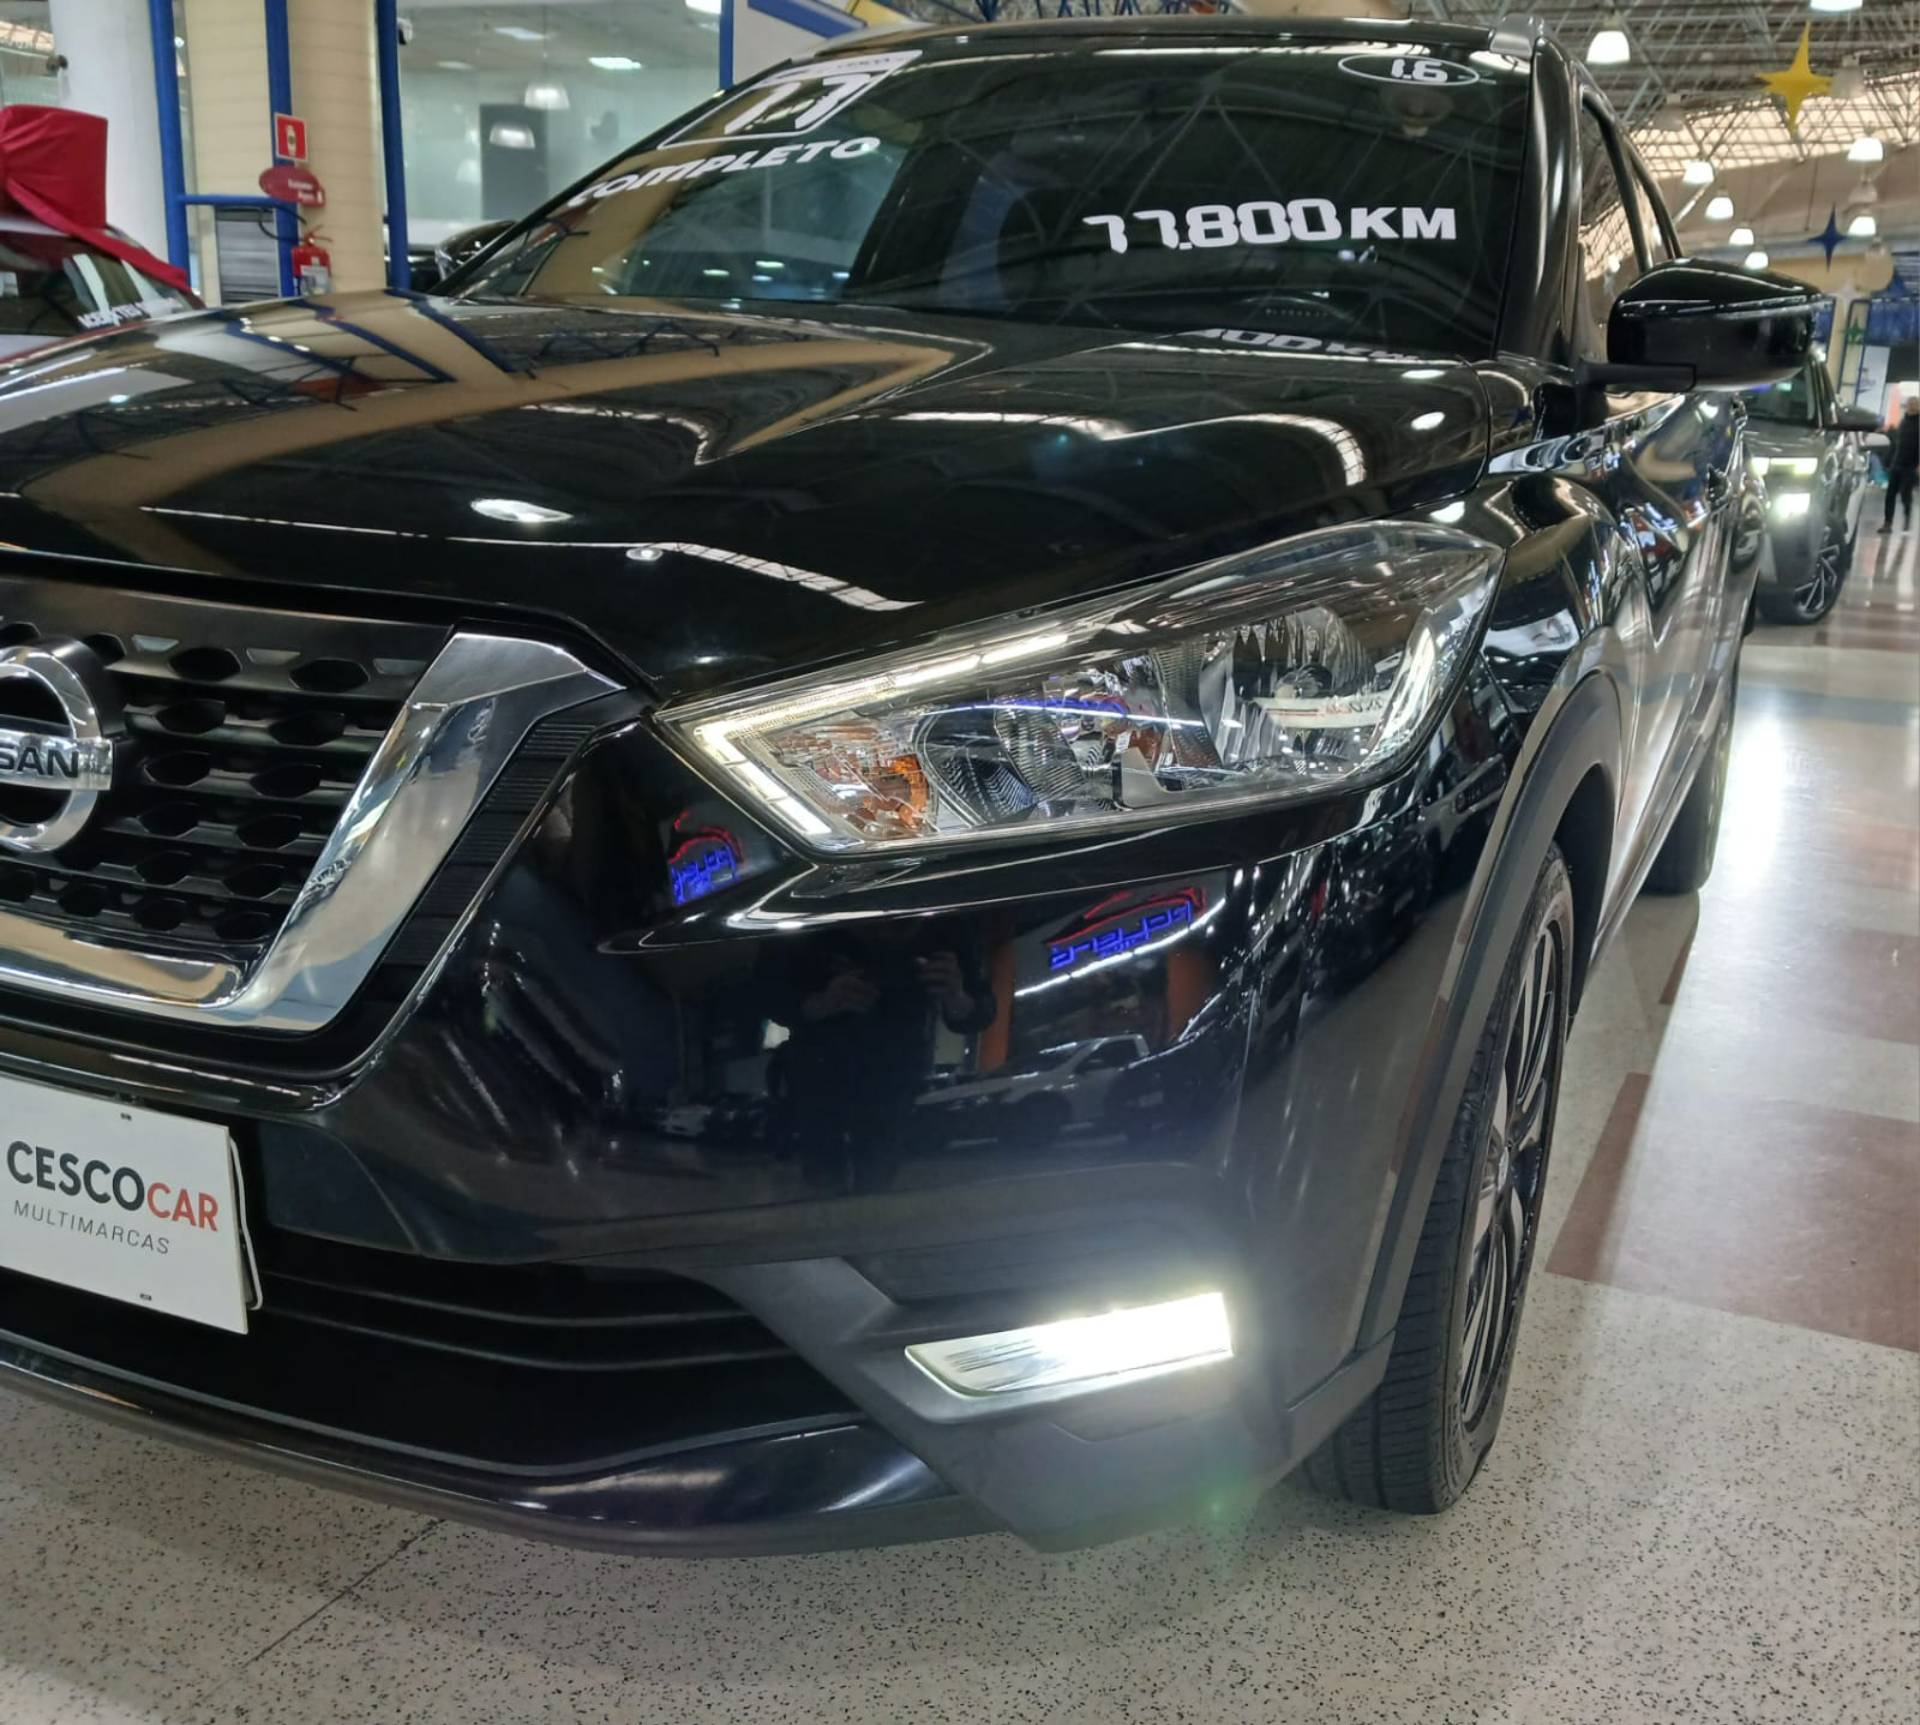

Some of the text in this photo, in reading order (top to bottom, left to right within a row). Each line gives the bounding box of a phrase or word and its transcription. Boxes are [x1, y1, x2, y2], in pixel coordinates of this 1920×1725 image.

[1391, 58, 1448, 83] 1.6
[566, 136, 881, 208] COMPLETO
[1083, 197, 1457, 254] 77.800 KM
[7, 1140, 219, 1232] CESCOCAR
[13, 1199, 171, 1255] MULTIMARCAS
